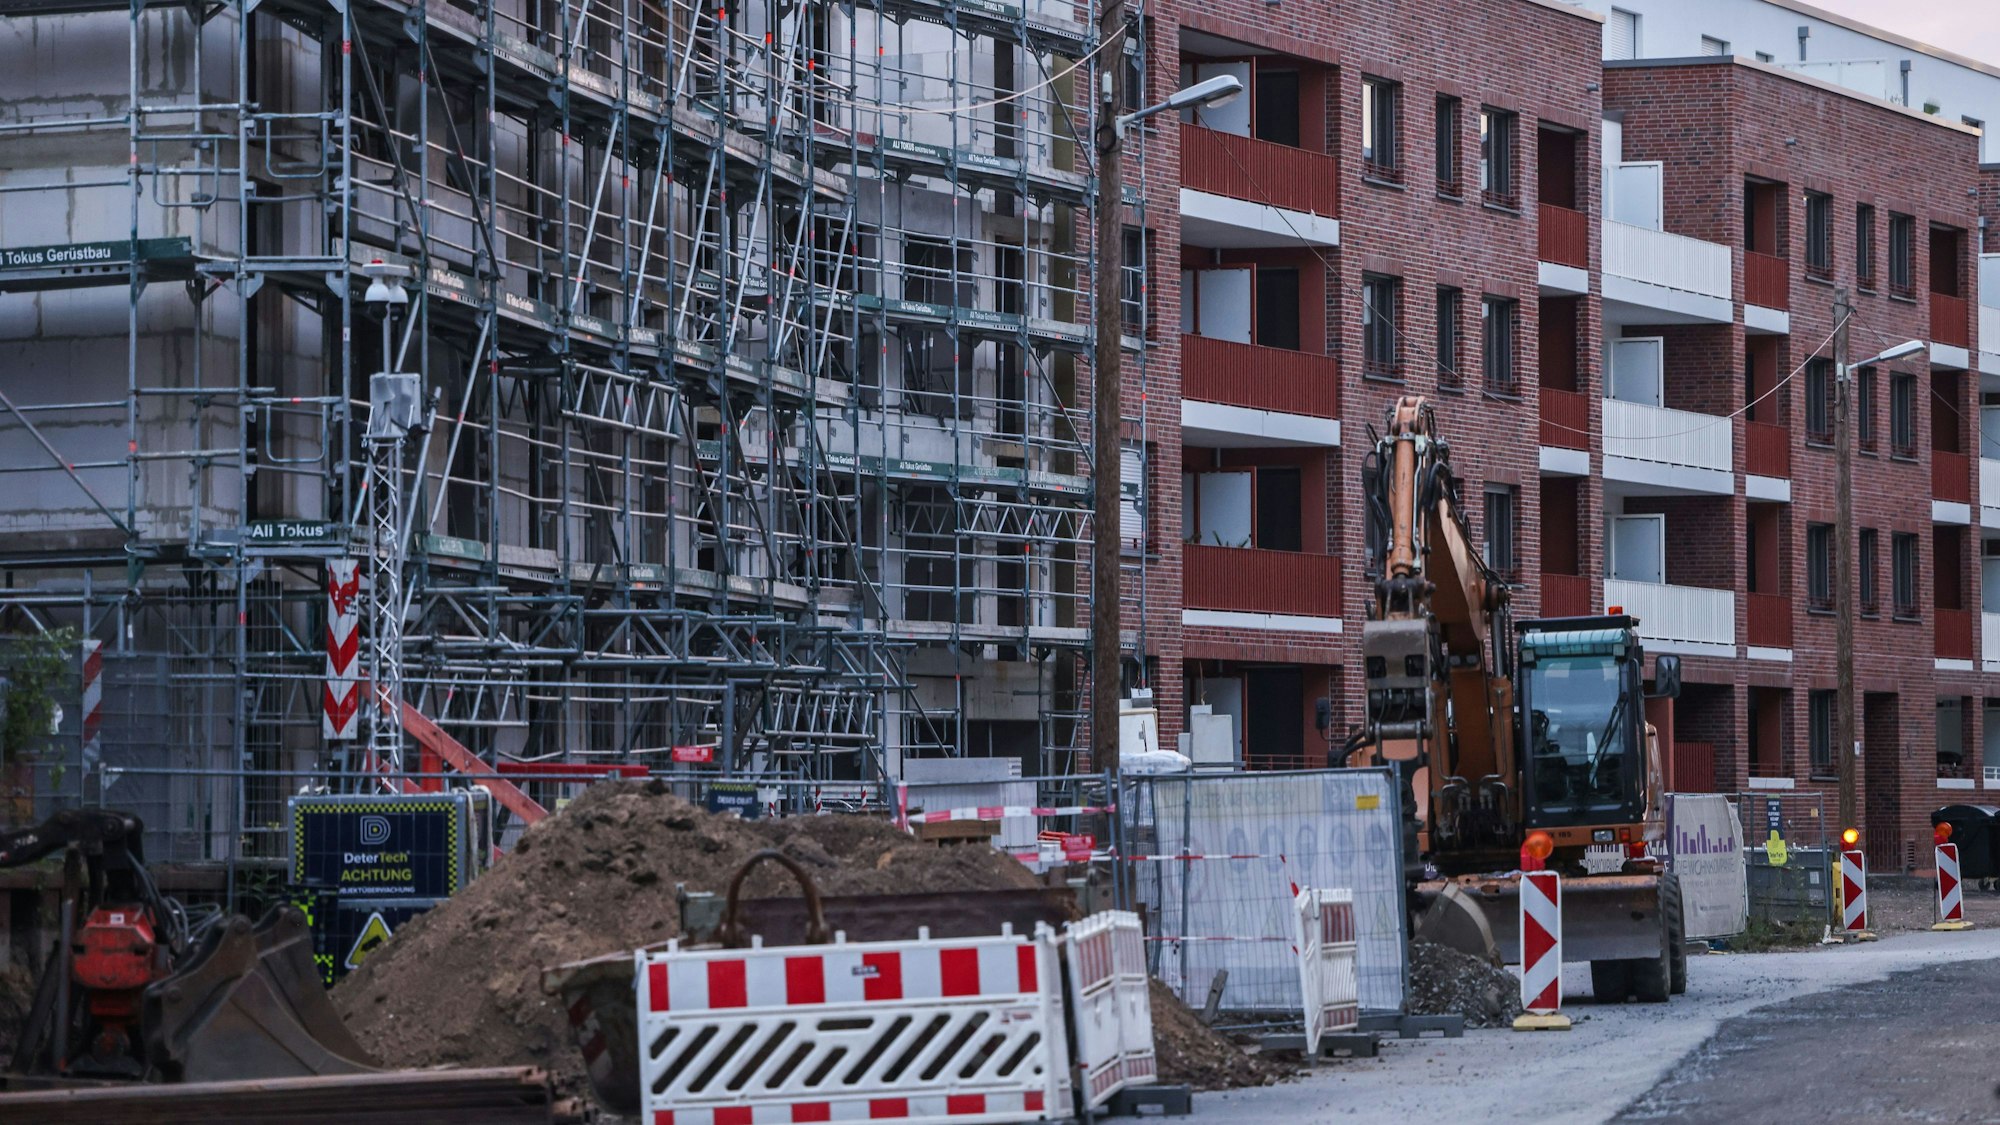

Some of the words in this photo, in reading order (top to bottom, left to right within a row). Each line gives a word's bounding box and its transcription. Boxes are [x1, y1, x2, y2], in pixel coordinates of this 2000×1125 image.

[901, 141, 914, 151] TOKUS
[6, 251, 43, 265] Tokus
[46, 245, 111, 262] Gerüstbau
[252, 524, 273, 537] Ali
[278, 523, 324, 537] Tokus
[344, 852, 409, 864] DeterTech
[341, 868, 412, 882] ACHTUNG
